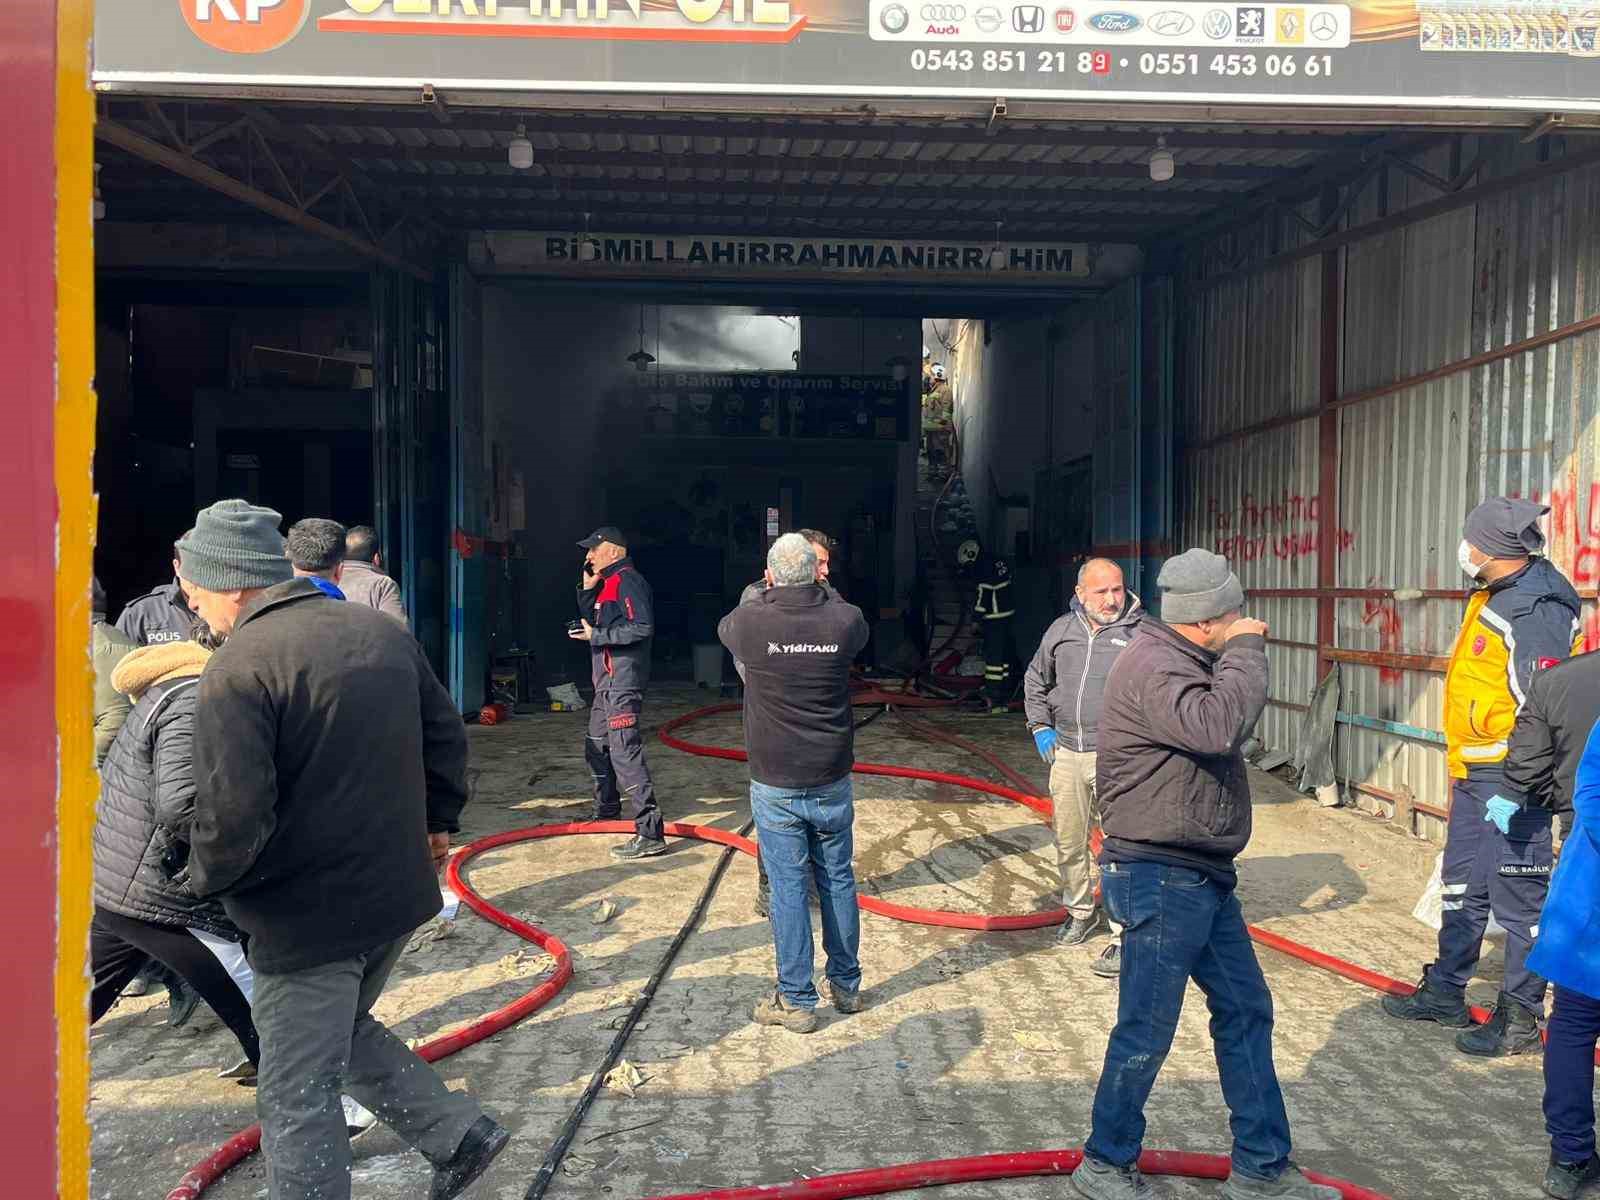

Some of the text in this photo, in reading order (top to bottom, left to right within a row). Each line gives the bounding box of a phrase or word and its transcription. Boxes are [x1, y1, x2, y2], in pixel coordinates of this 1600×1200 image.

[1098, 14, 1130, 29] Ford
[926, 24, 960, 34] Audi
[910, 50, 1332, 76] 0543 851 21 89 0551 453 06 61
[740, 377, 760, 387] ve
